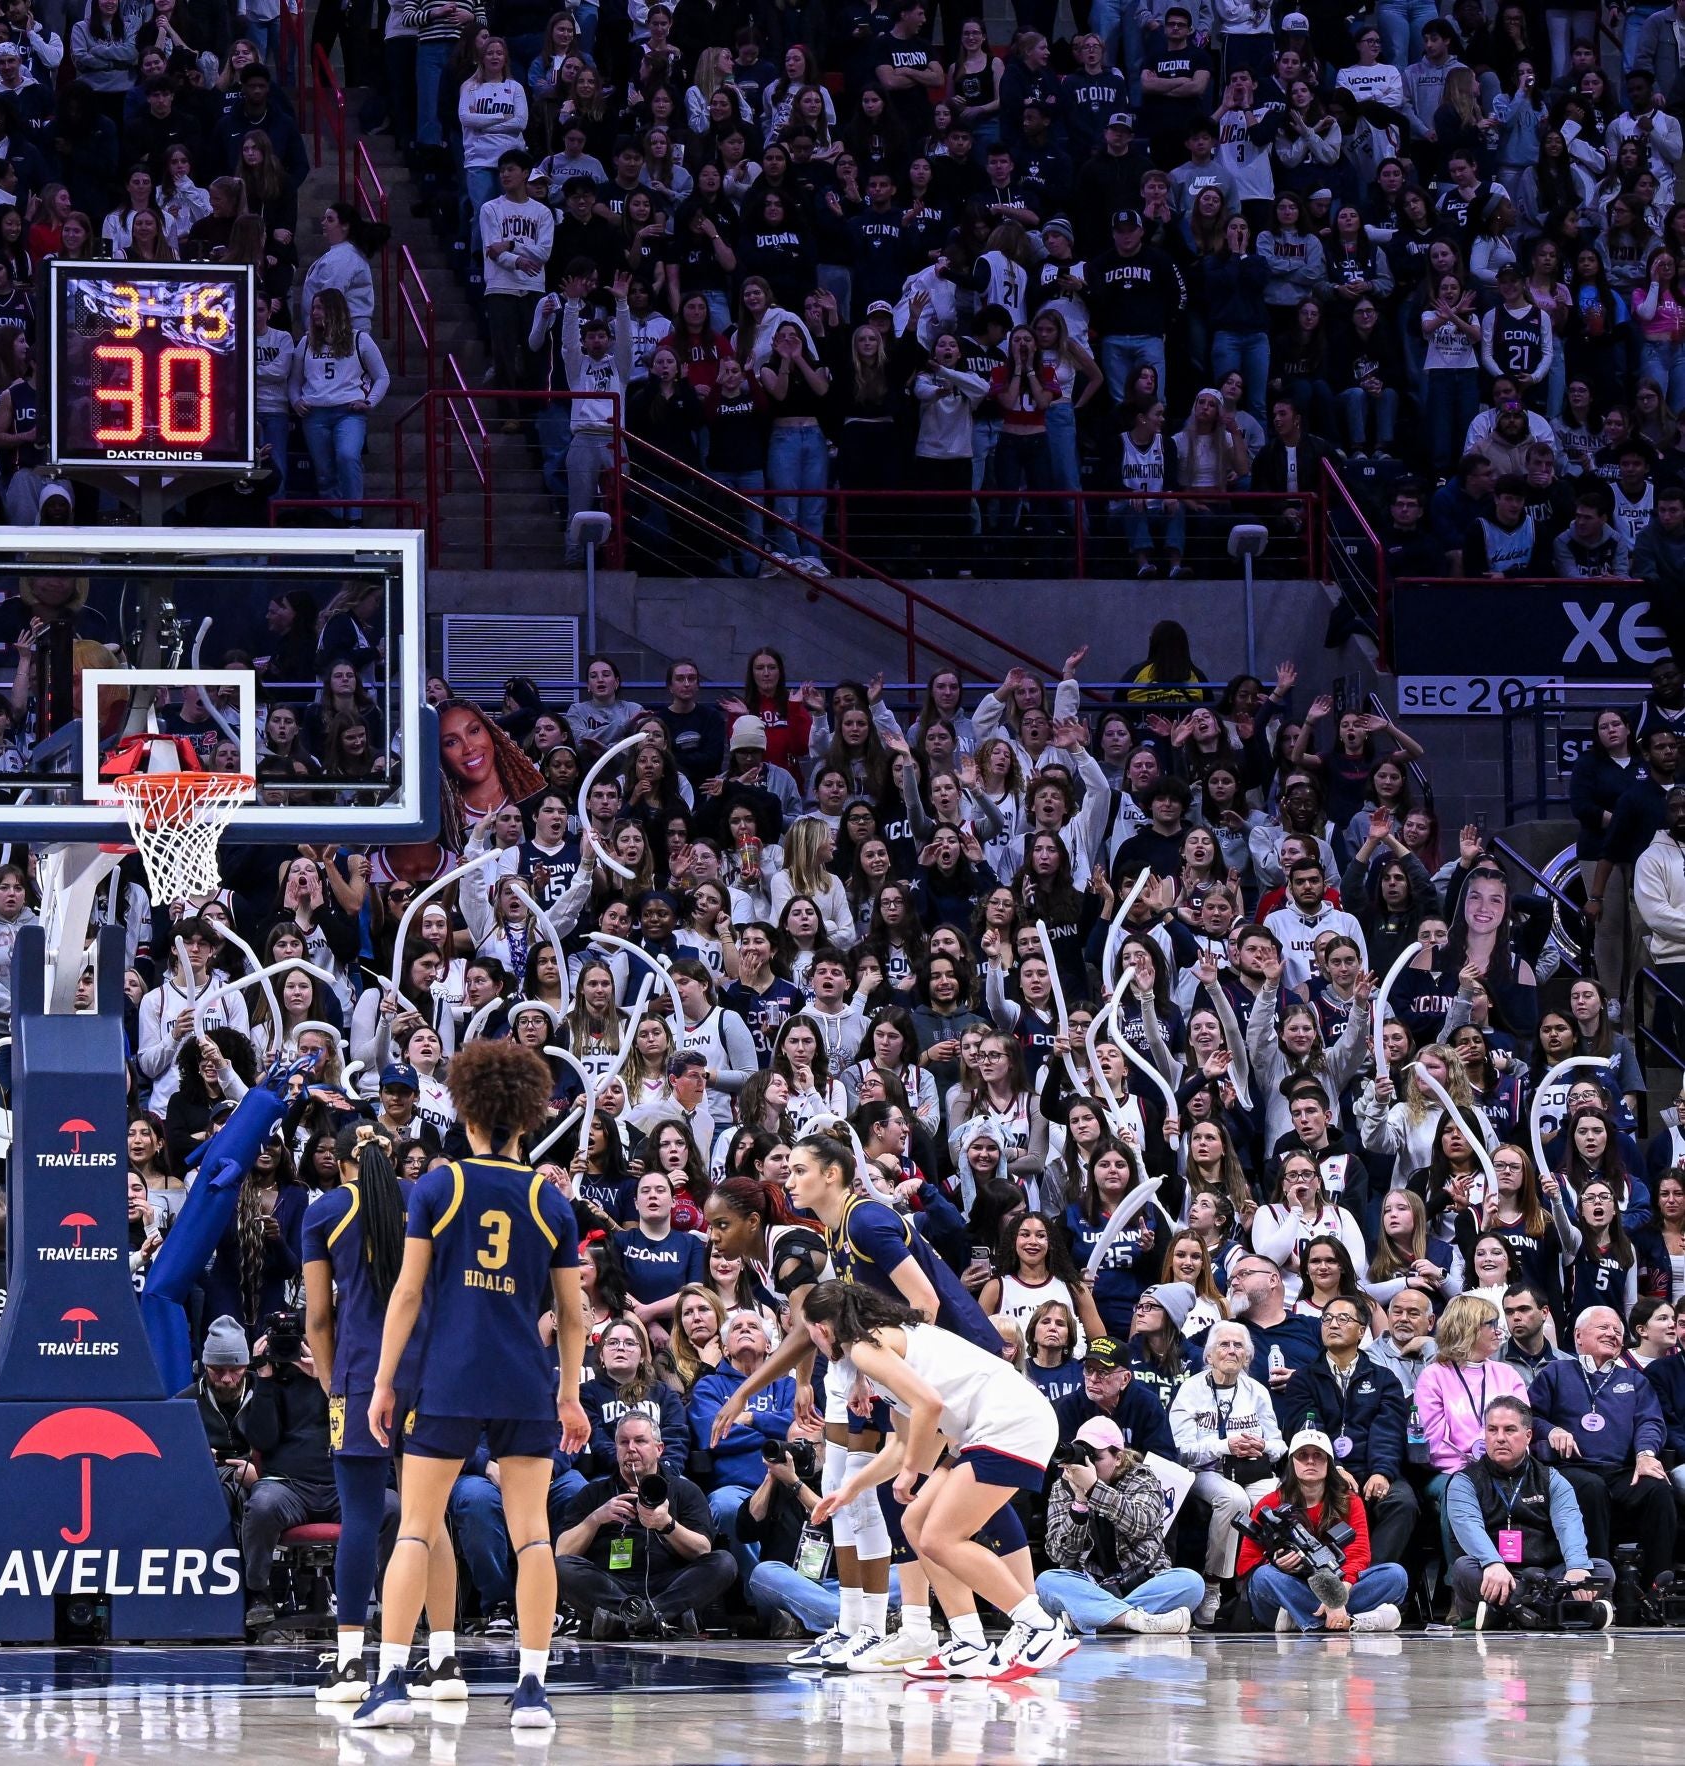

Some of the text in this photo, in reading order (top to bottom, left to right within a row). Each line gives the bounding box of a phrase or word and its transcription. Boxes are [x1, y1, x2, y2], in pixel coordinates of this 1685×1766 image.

[892, 52, 927, 66] UCONN
[1157, 59, 1190, 72] UCONN
[1348, 75, 1386, 85] UCONN
[1235, 145, 1246, 162] 3
[1194, 176, 1217, 187] NIKE
[1457, 211, 1468, 225] 5
[757, 233, 799, 247] UCONN
[1105, 268, 1151, 283] UCONN
[1004, 284, 1018, 308] 21
[114, 285, 227, 339] 3:15
[1509, 345, 1530, 369] 21
[323, 362, 336, 379] 5
[92, 347, 211, 442] 30
[1565, 434, 1607, 447] UCONN
[107, 449, 203, 461] DAKTRONICS
[1404, 687, 1456, 705] SEC
[36, 1153, 116, 1167] TRAVELERS
[477, 1210, 511, 1269] 3
[37, 1246, 118, 1261] TRAVELERS
[465, 1270, 515, 1295] HIDALGO
[1594, 1269, 1608, 1289] 5
[37, 1342, 119, 1356] TRAVELERS
